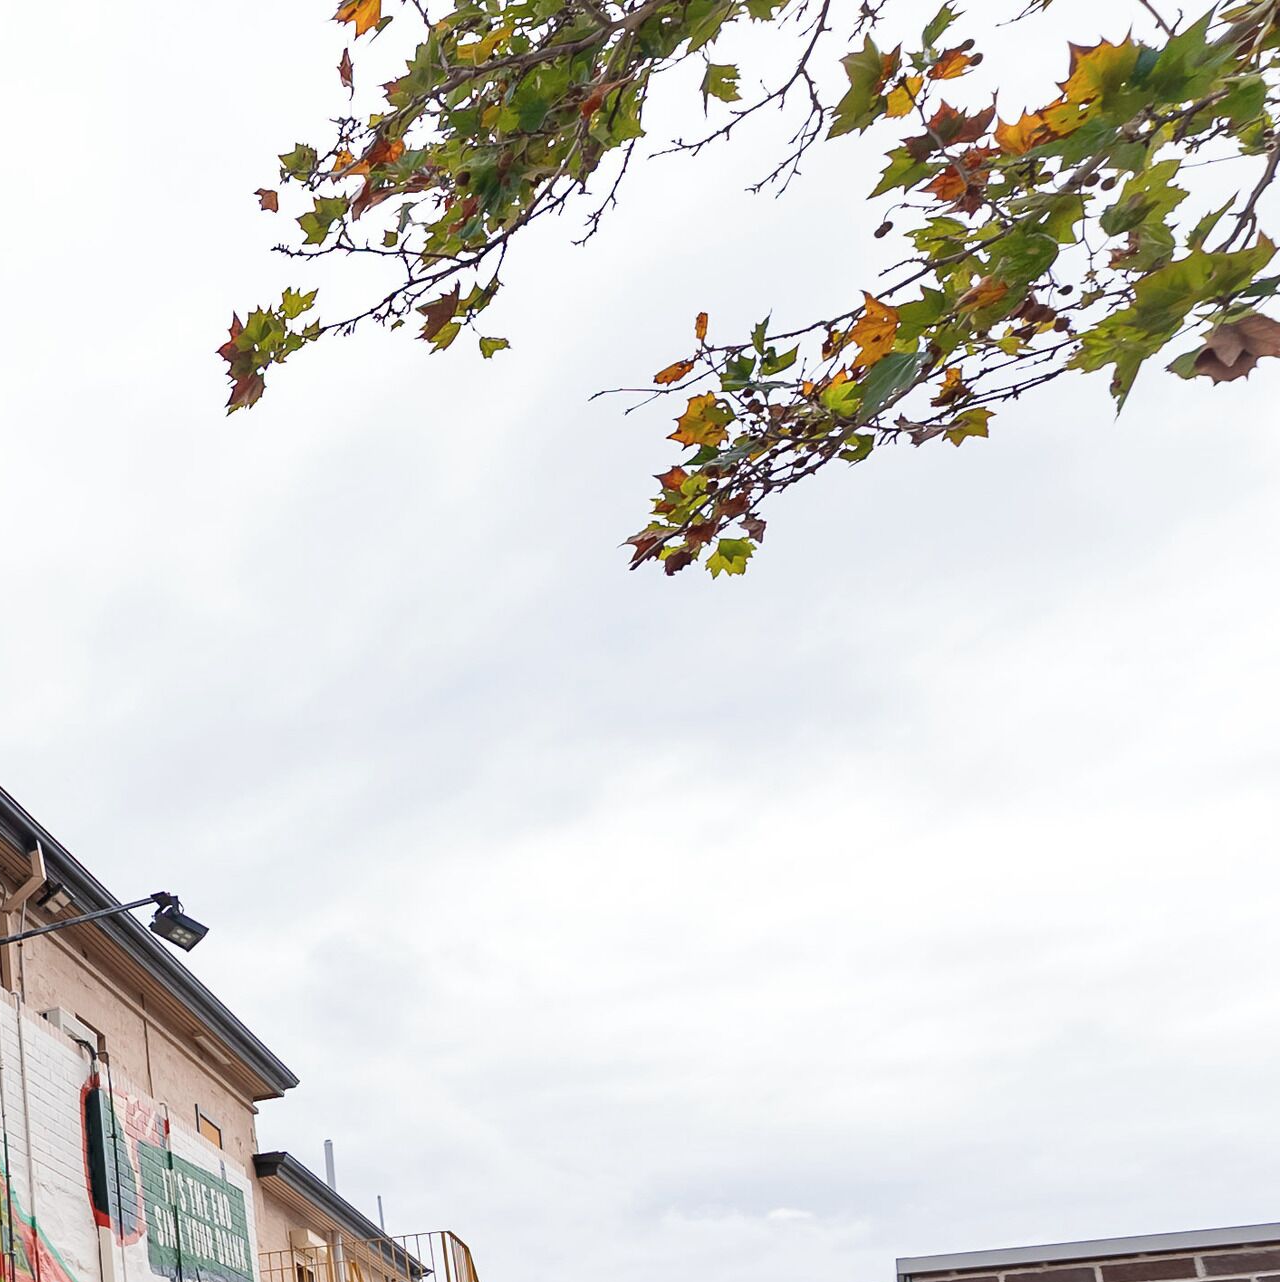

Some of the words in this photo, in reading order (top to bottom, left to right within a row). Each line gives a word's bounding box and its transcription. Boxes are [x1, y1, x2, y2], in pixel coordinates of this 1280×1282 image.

[186, 1177, 211, 1221] THE
[210, 1188, 232, 1230] END
[185, 1217, 215, 1260] YOUR
[215, 1227, 248, 1272] DRINK
